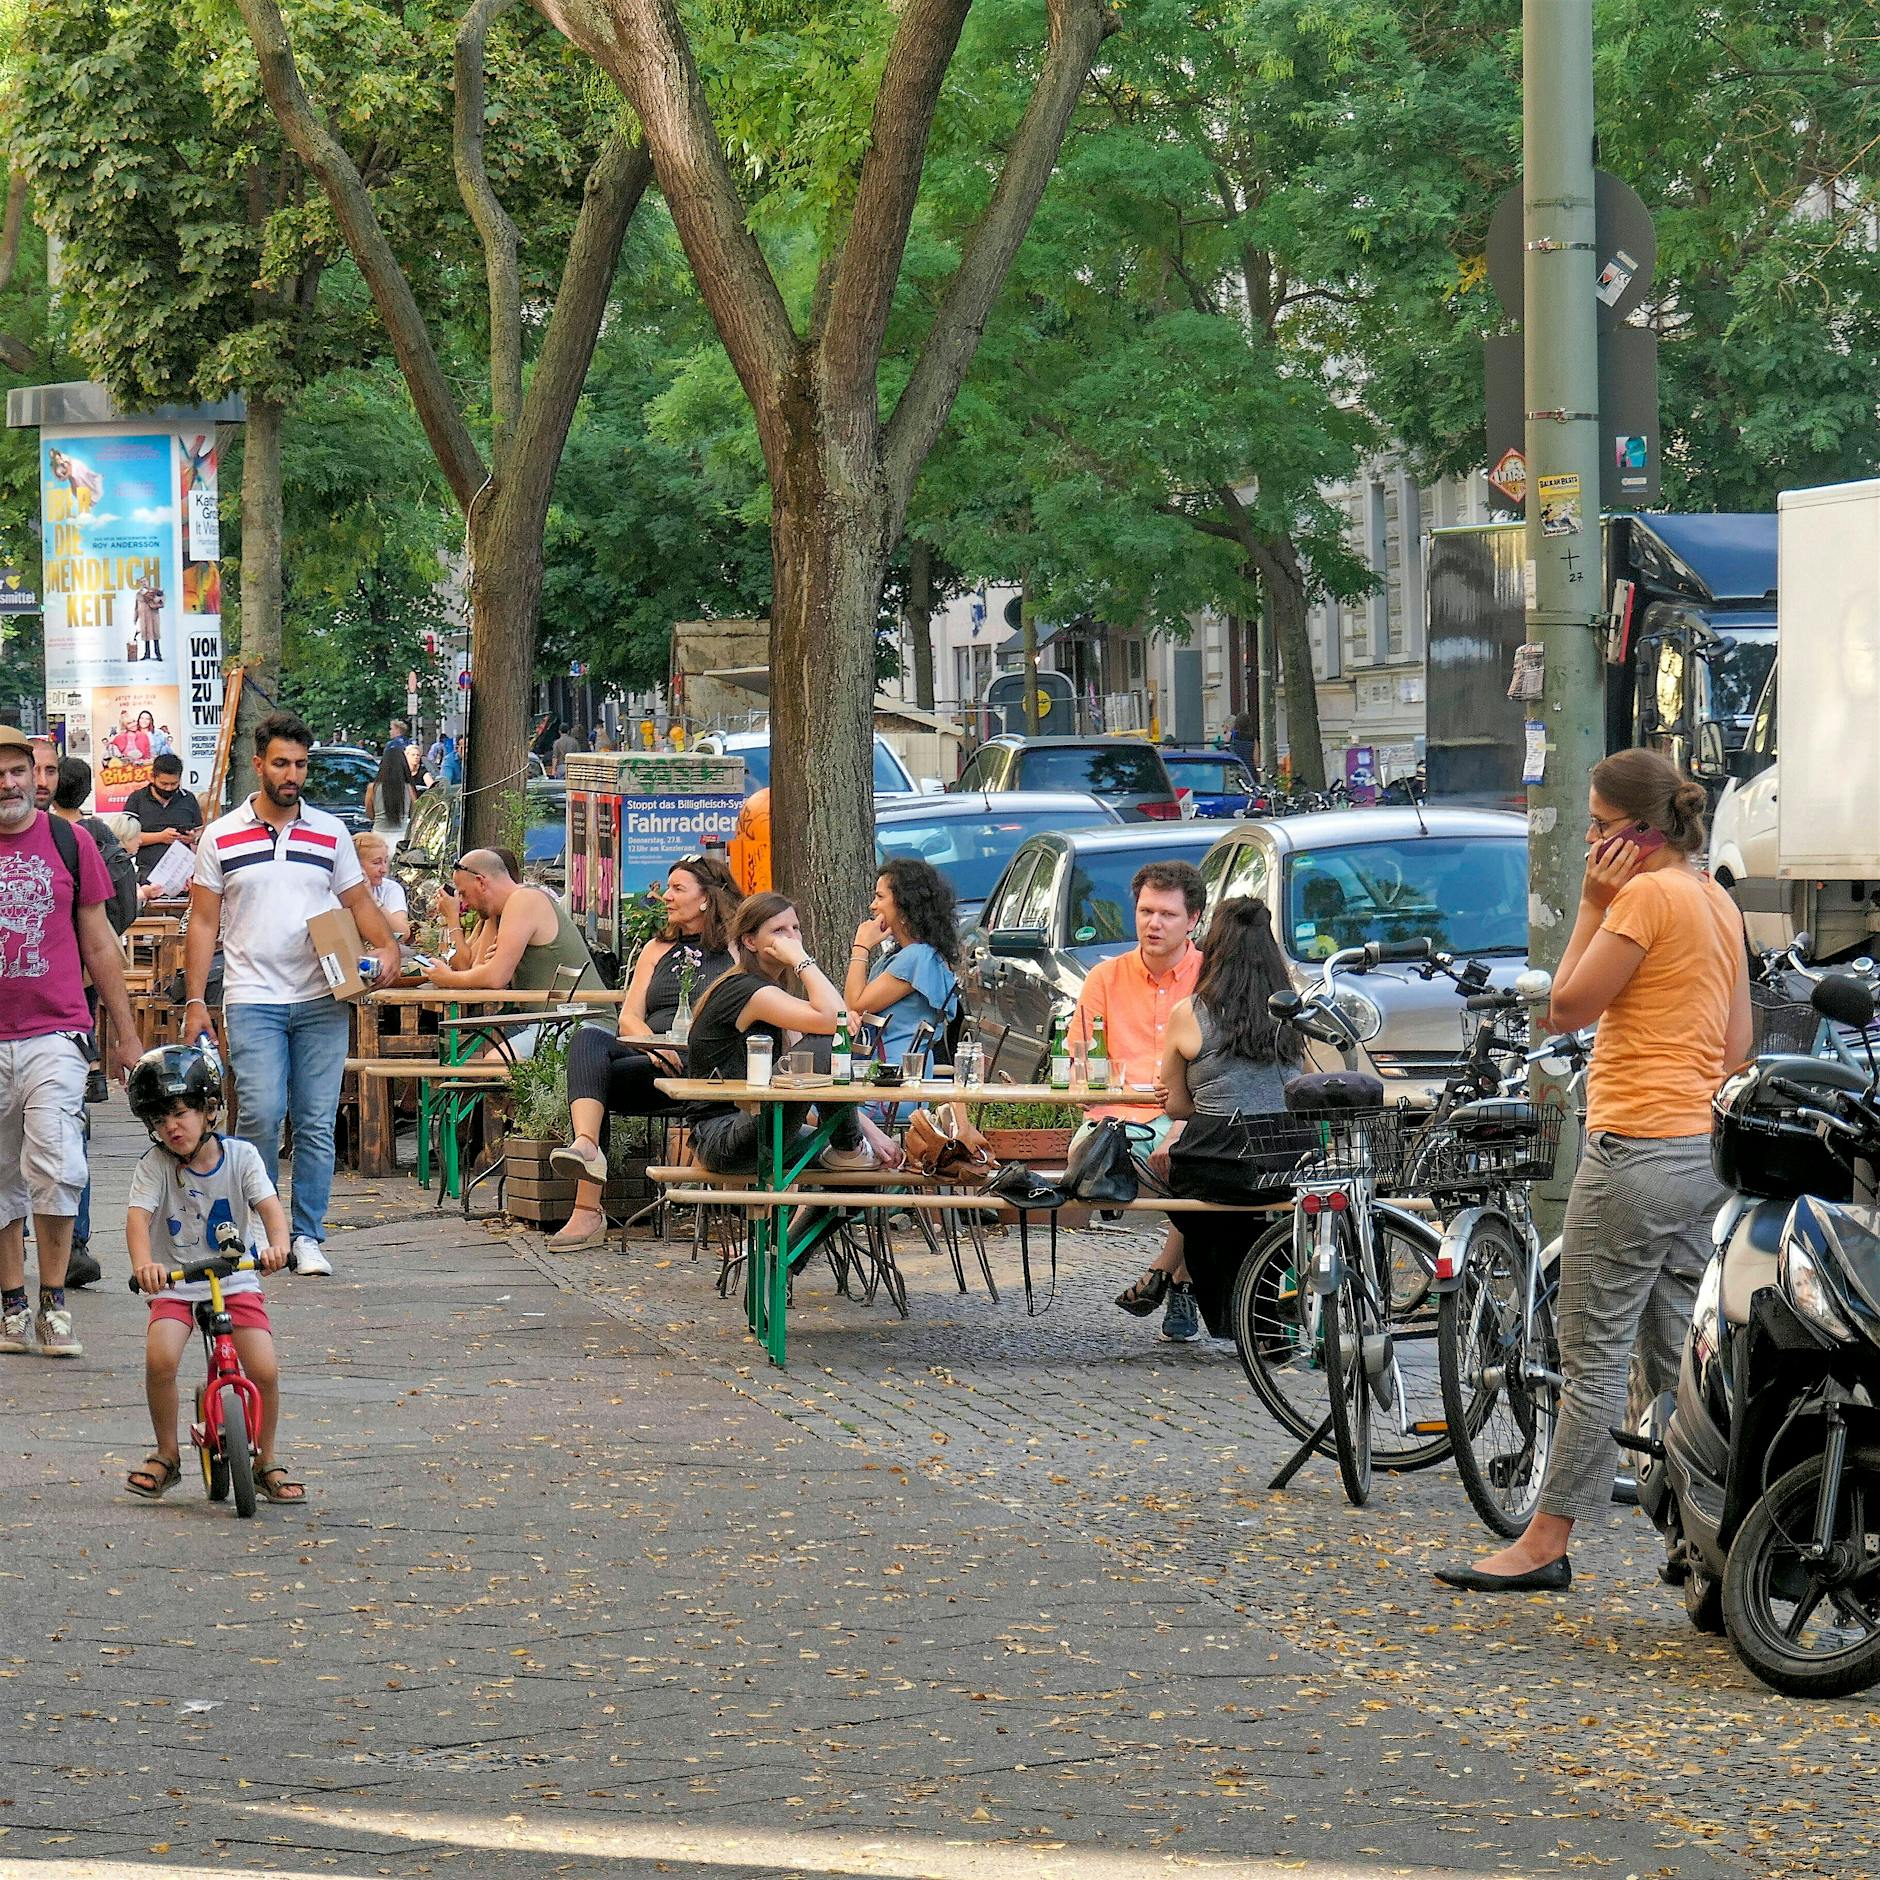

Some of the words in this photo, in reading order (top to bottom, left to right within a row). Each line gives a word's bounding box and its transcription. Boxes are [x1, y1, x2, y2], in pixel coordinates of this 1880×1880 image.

[54, 523, 84, 556] DIE
[92, 541, 107, 549] ROY
[111, 541, 160, 549] ANDERSSON
[66, 593, 117, 628] KEIT
[190, 637, 218, 657] VON
[191, 682, 212, 702] ZU
[101, 765, 133, 786] Bibi
[627, 799, 657, 810] Stoppt
[660, 799, 676, 809] das
